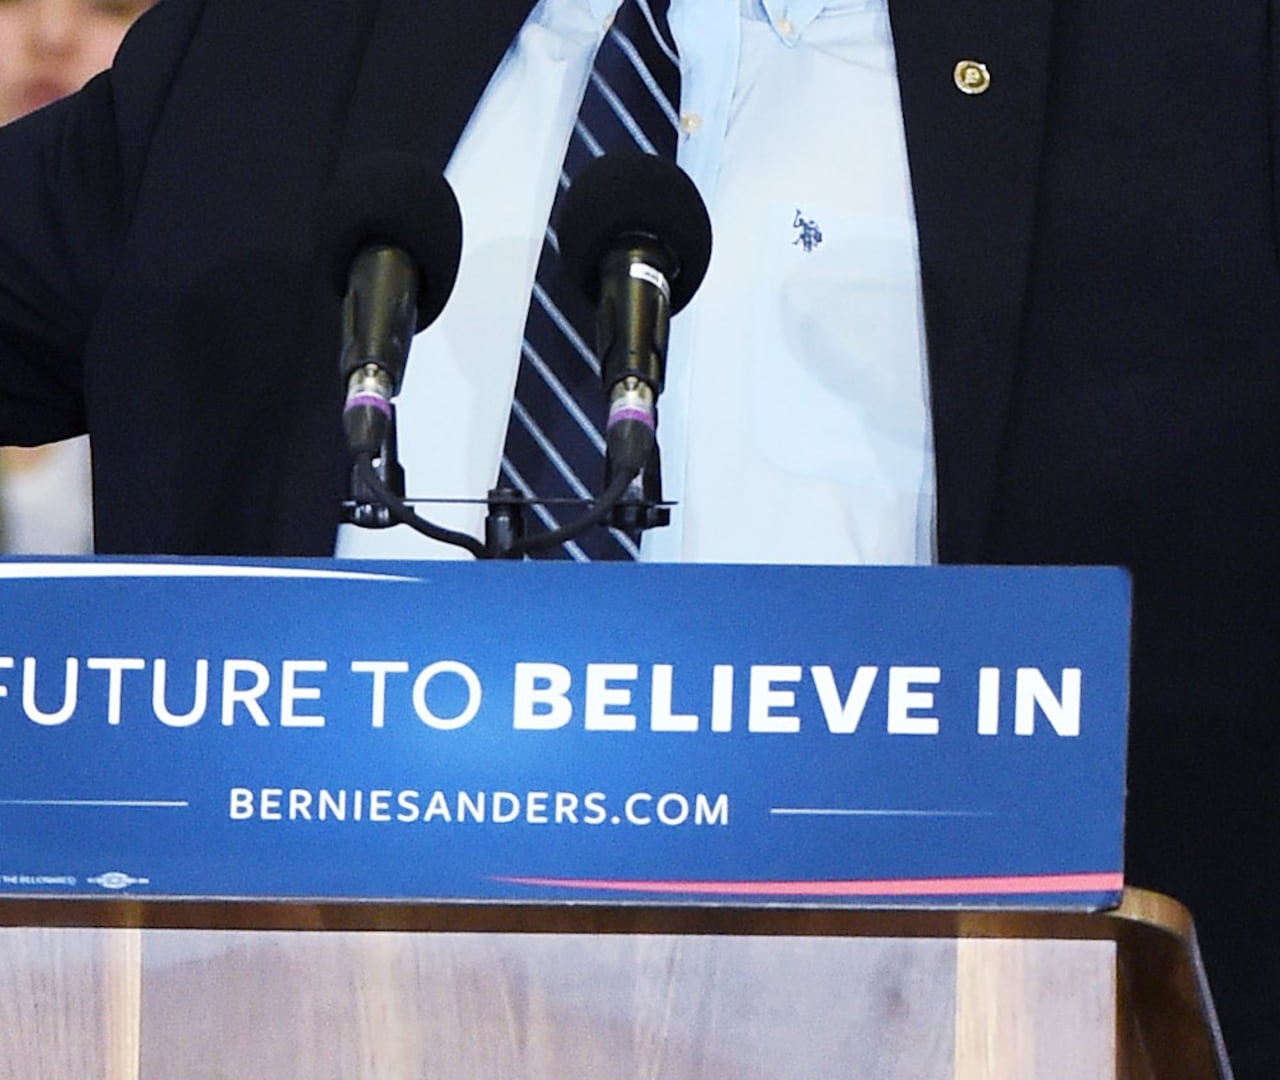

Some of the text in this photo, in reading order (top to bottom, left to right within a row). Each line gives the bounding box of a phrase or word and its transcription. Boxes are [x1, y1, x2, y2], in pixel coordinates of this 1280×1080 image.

[351, 660, 483, 732] TO
[511, 662, 942, 736] BELIEVE
[976, 666, 1082, 737] IN
[229, 787, 730, 826] BERNIESANDERS.COM
